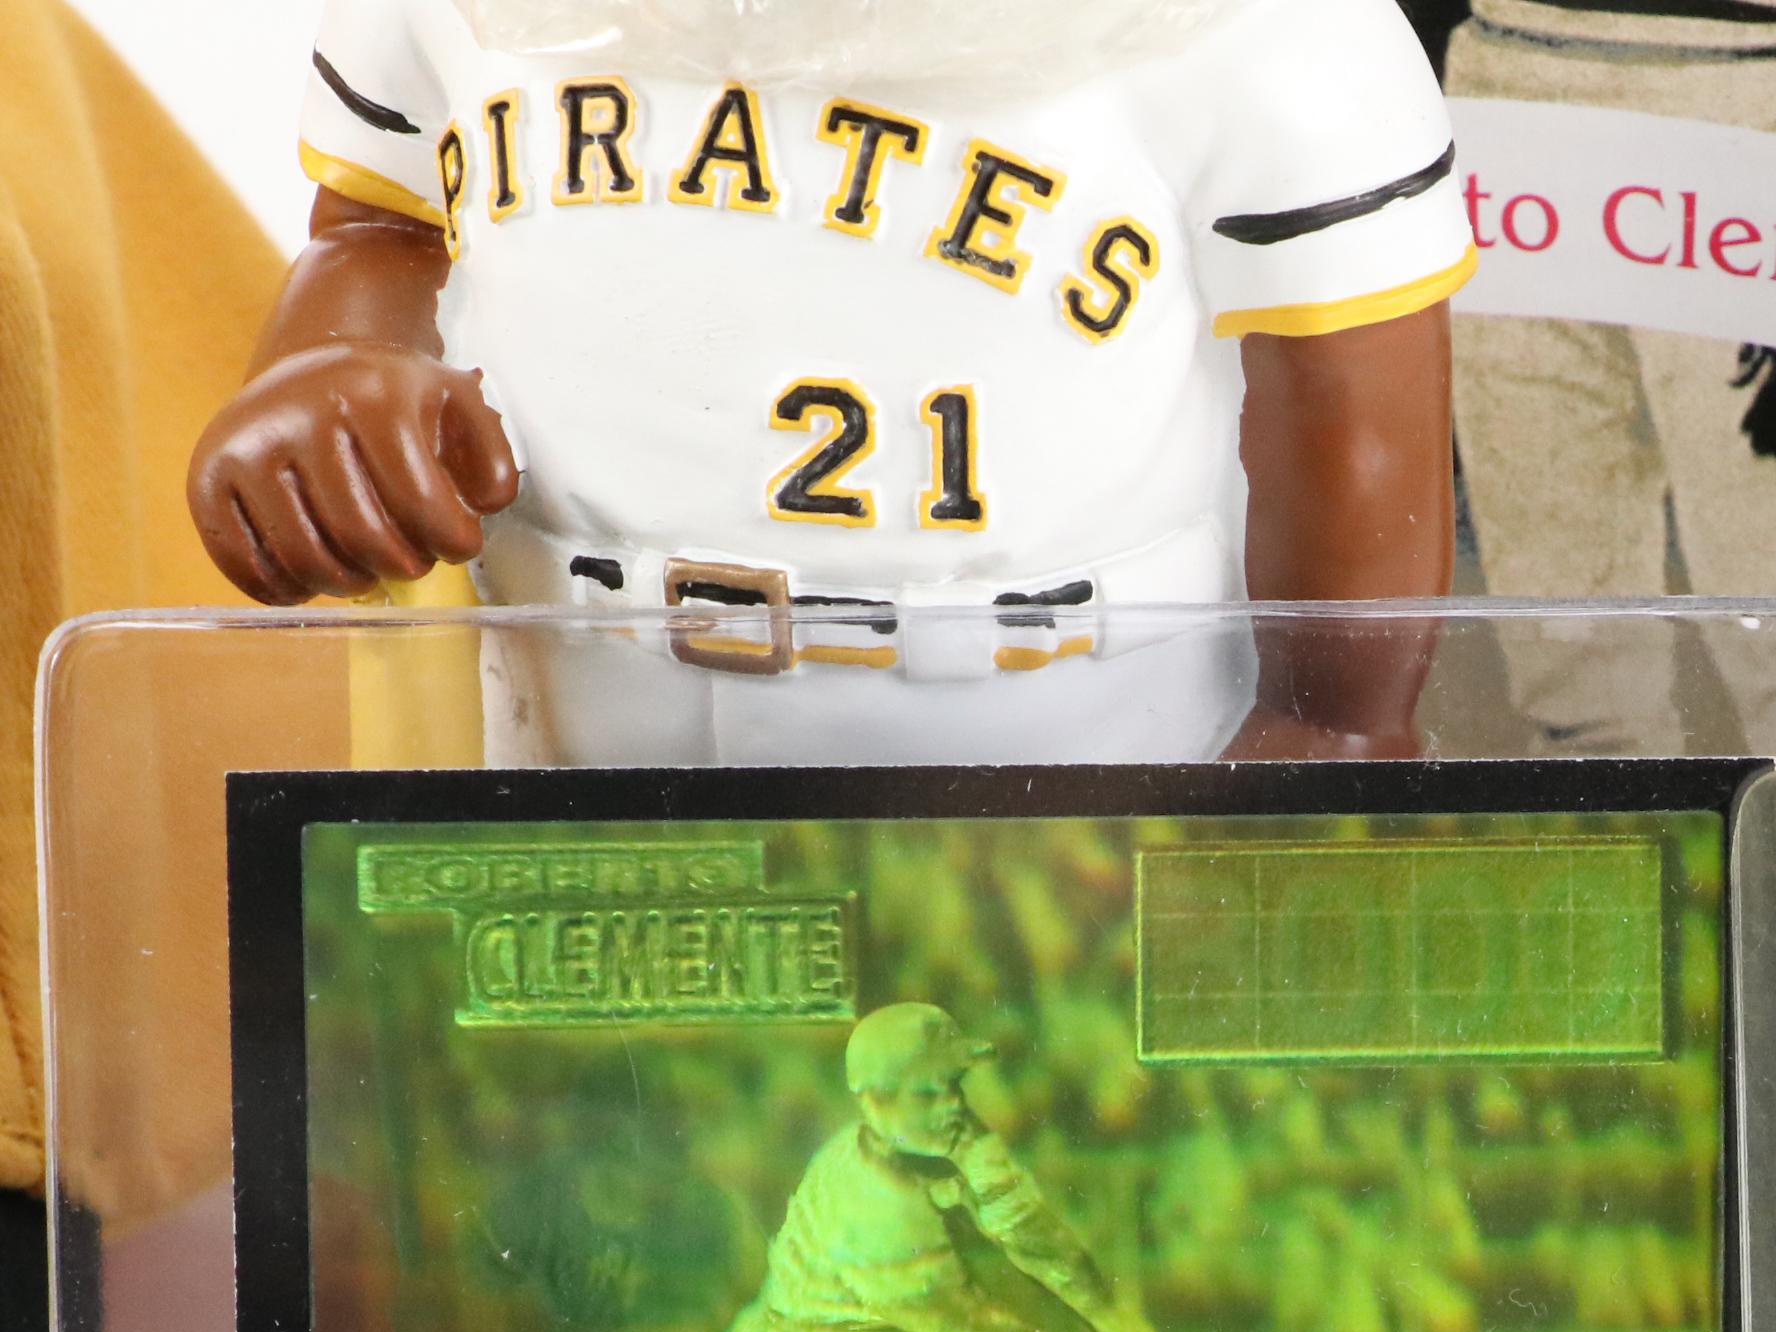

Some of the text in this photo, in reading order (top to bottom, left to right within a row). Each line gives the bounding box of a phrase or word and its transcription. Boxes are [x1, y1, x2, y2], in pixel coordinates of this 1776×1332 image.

[437, 74, 1160, 344] PIRATES
[768, 376, 988, 531] 21
[466, 908, 845, 1003] CLEMENTE
